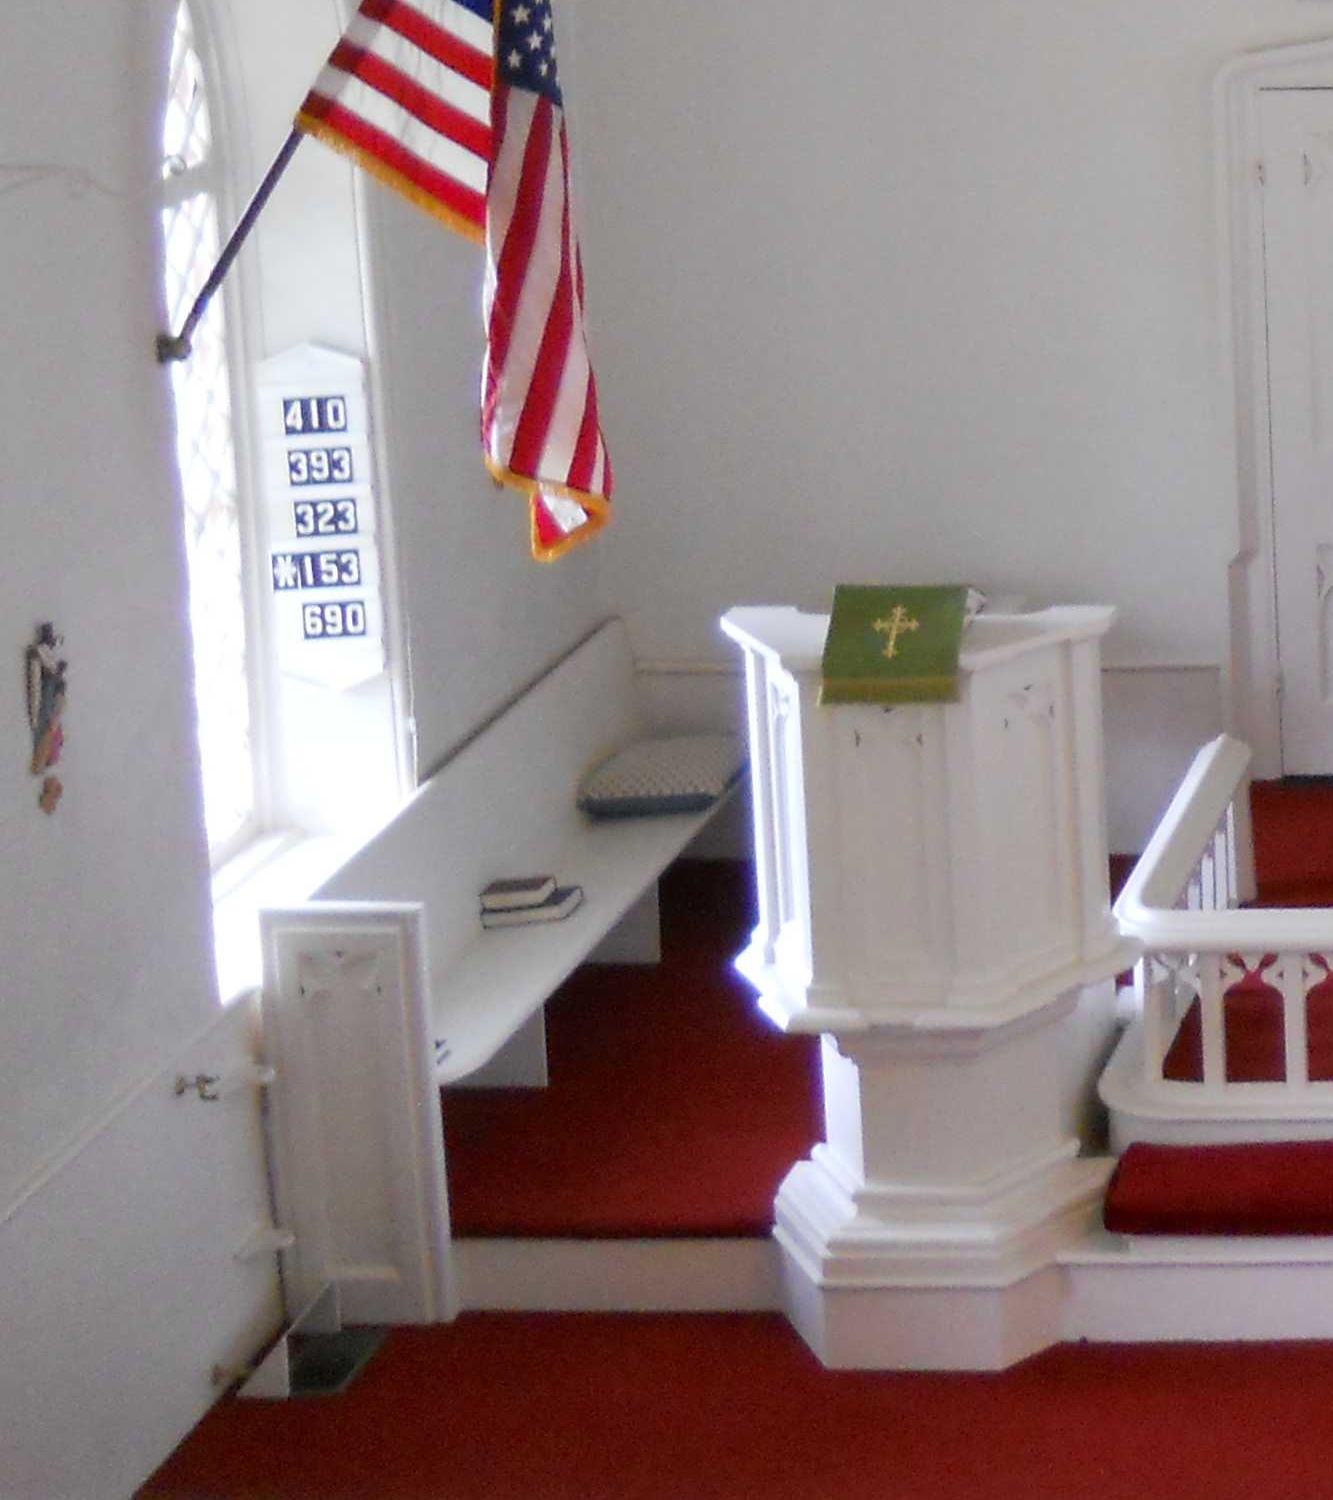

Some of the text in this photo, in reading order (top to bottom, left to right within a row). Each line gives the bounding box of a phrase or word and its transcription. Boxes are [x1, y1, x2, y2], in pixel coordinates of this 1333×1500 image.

[284, 399, 345, 432] 410
[289, 450, 351, 484] 393
[296, 501, 356, 534] 323
[304, 603, 364, 637] 690
